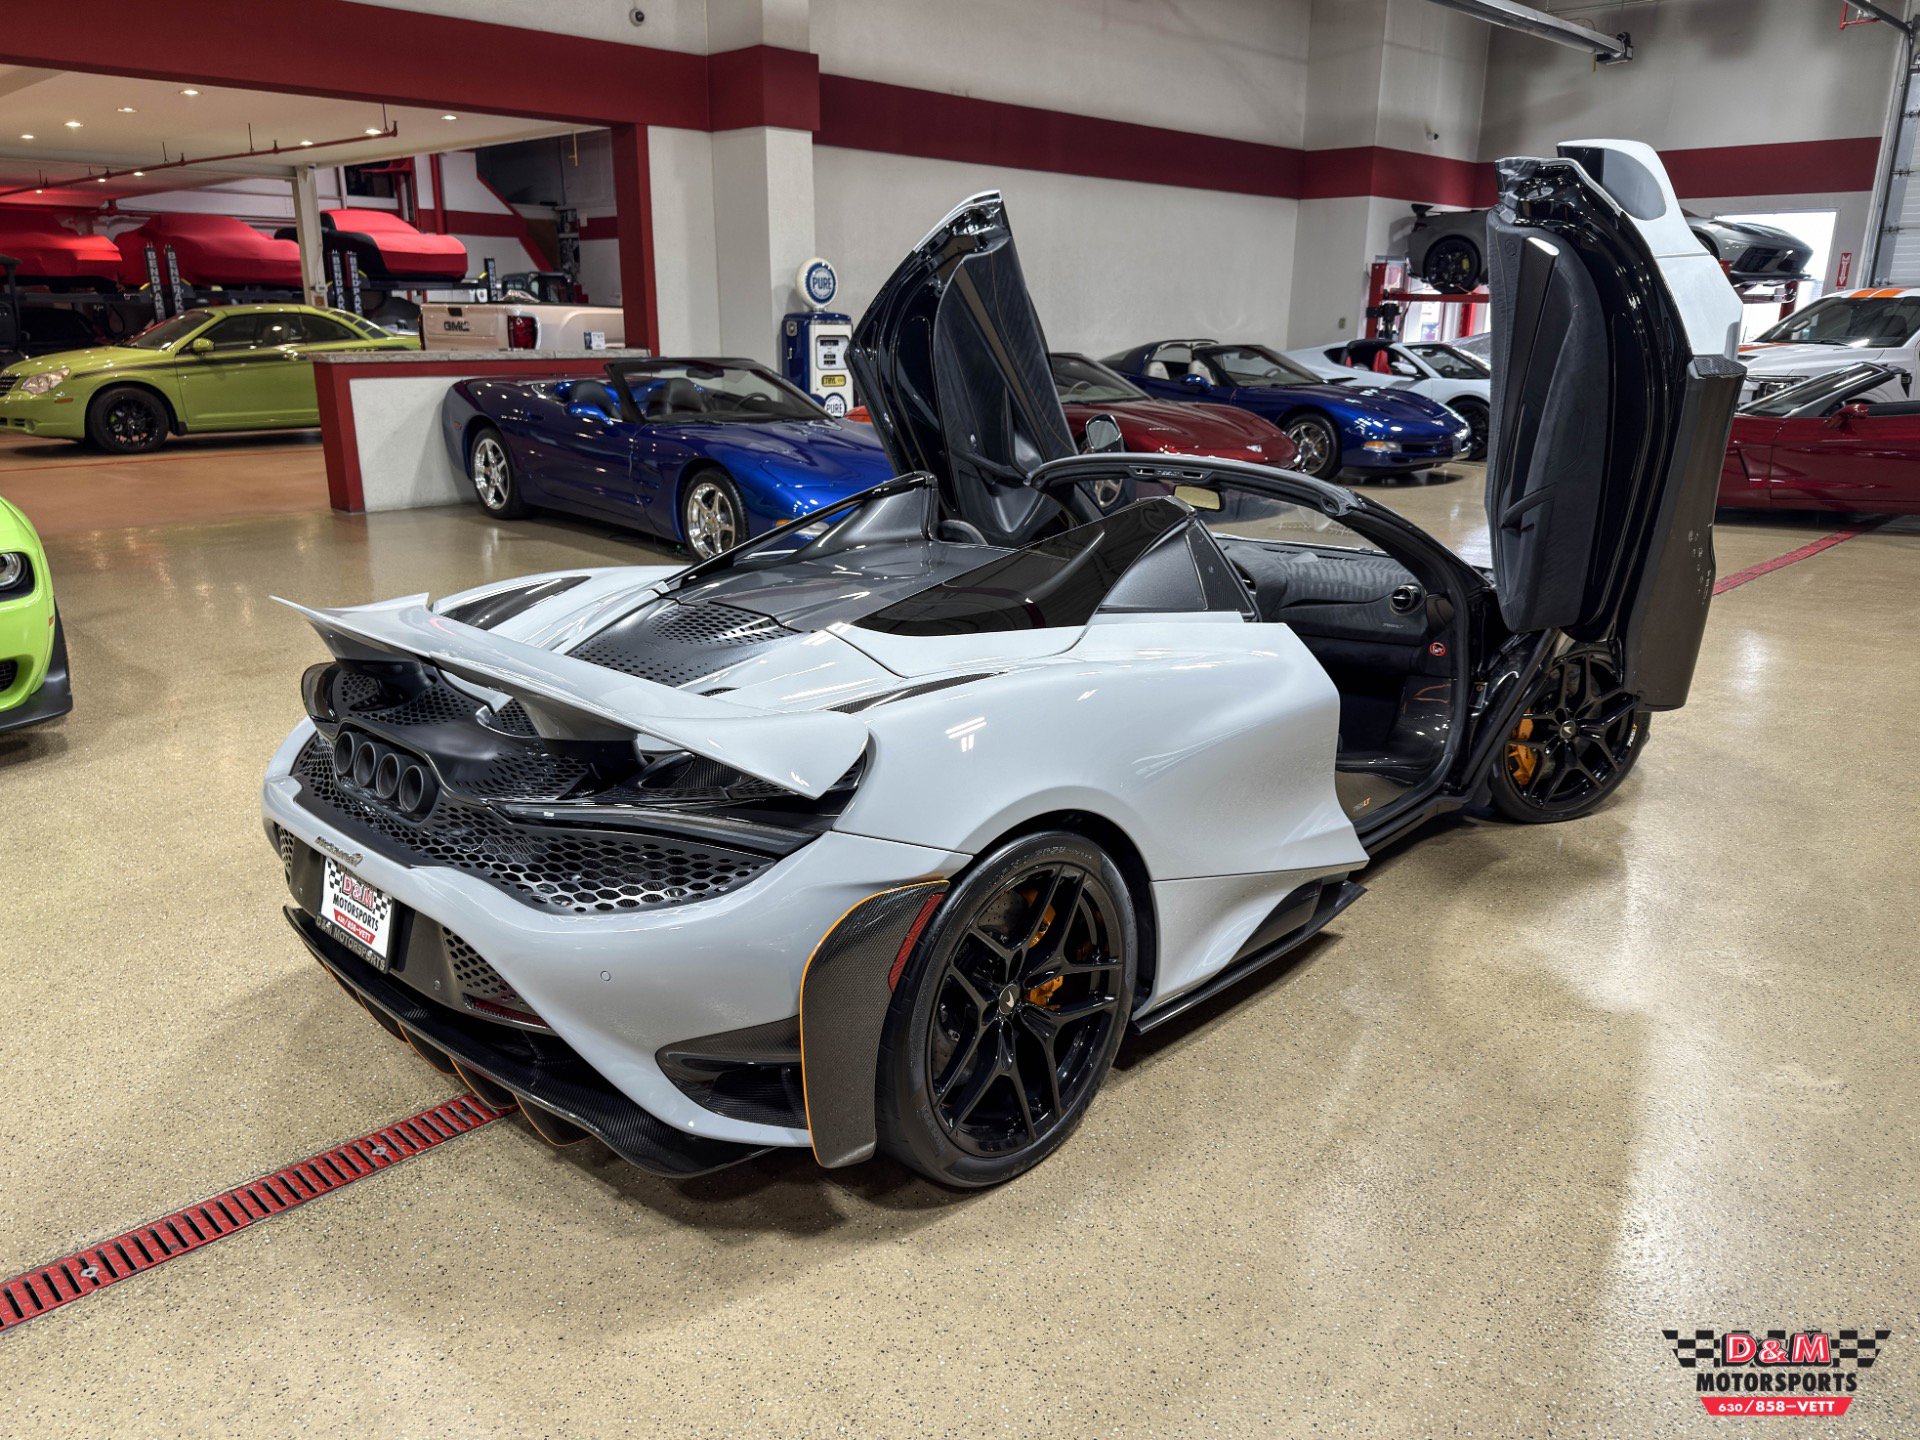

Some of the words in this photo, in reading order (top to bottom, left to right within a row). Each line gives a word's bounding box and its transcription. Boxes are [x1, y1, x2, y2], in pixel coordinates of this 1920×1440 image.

[812, 277, 832, 290] PURE
[444, 321, 470, 332] GMC
[826, 404, 843, 414] PURE
[342, 873, 375, 910] D&M
[333, 893, 379, 932] MOTORSPORTS
[333, 927, 386, 971] MOTORSPORTS
